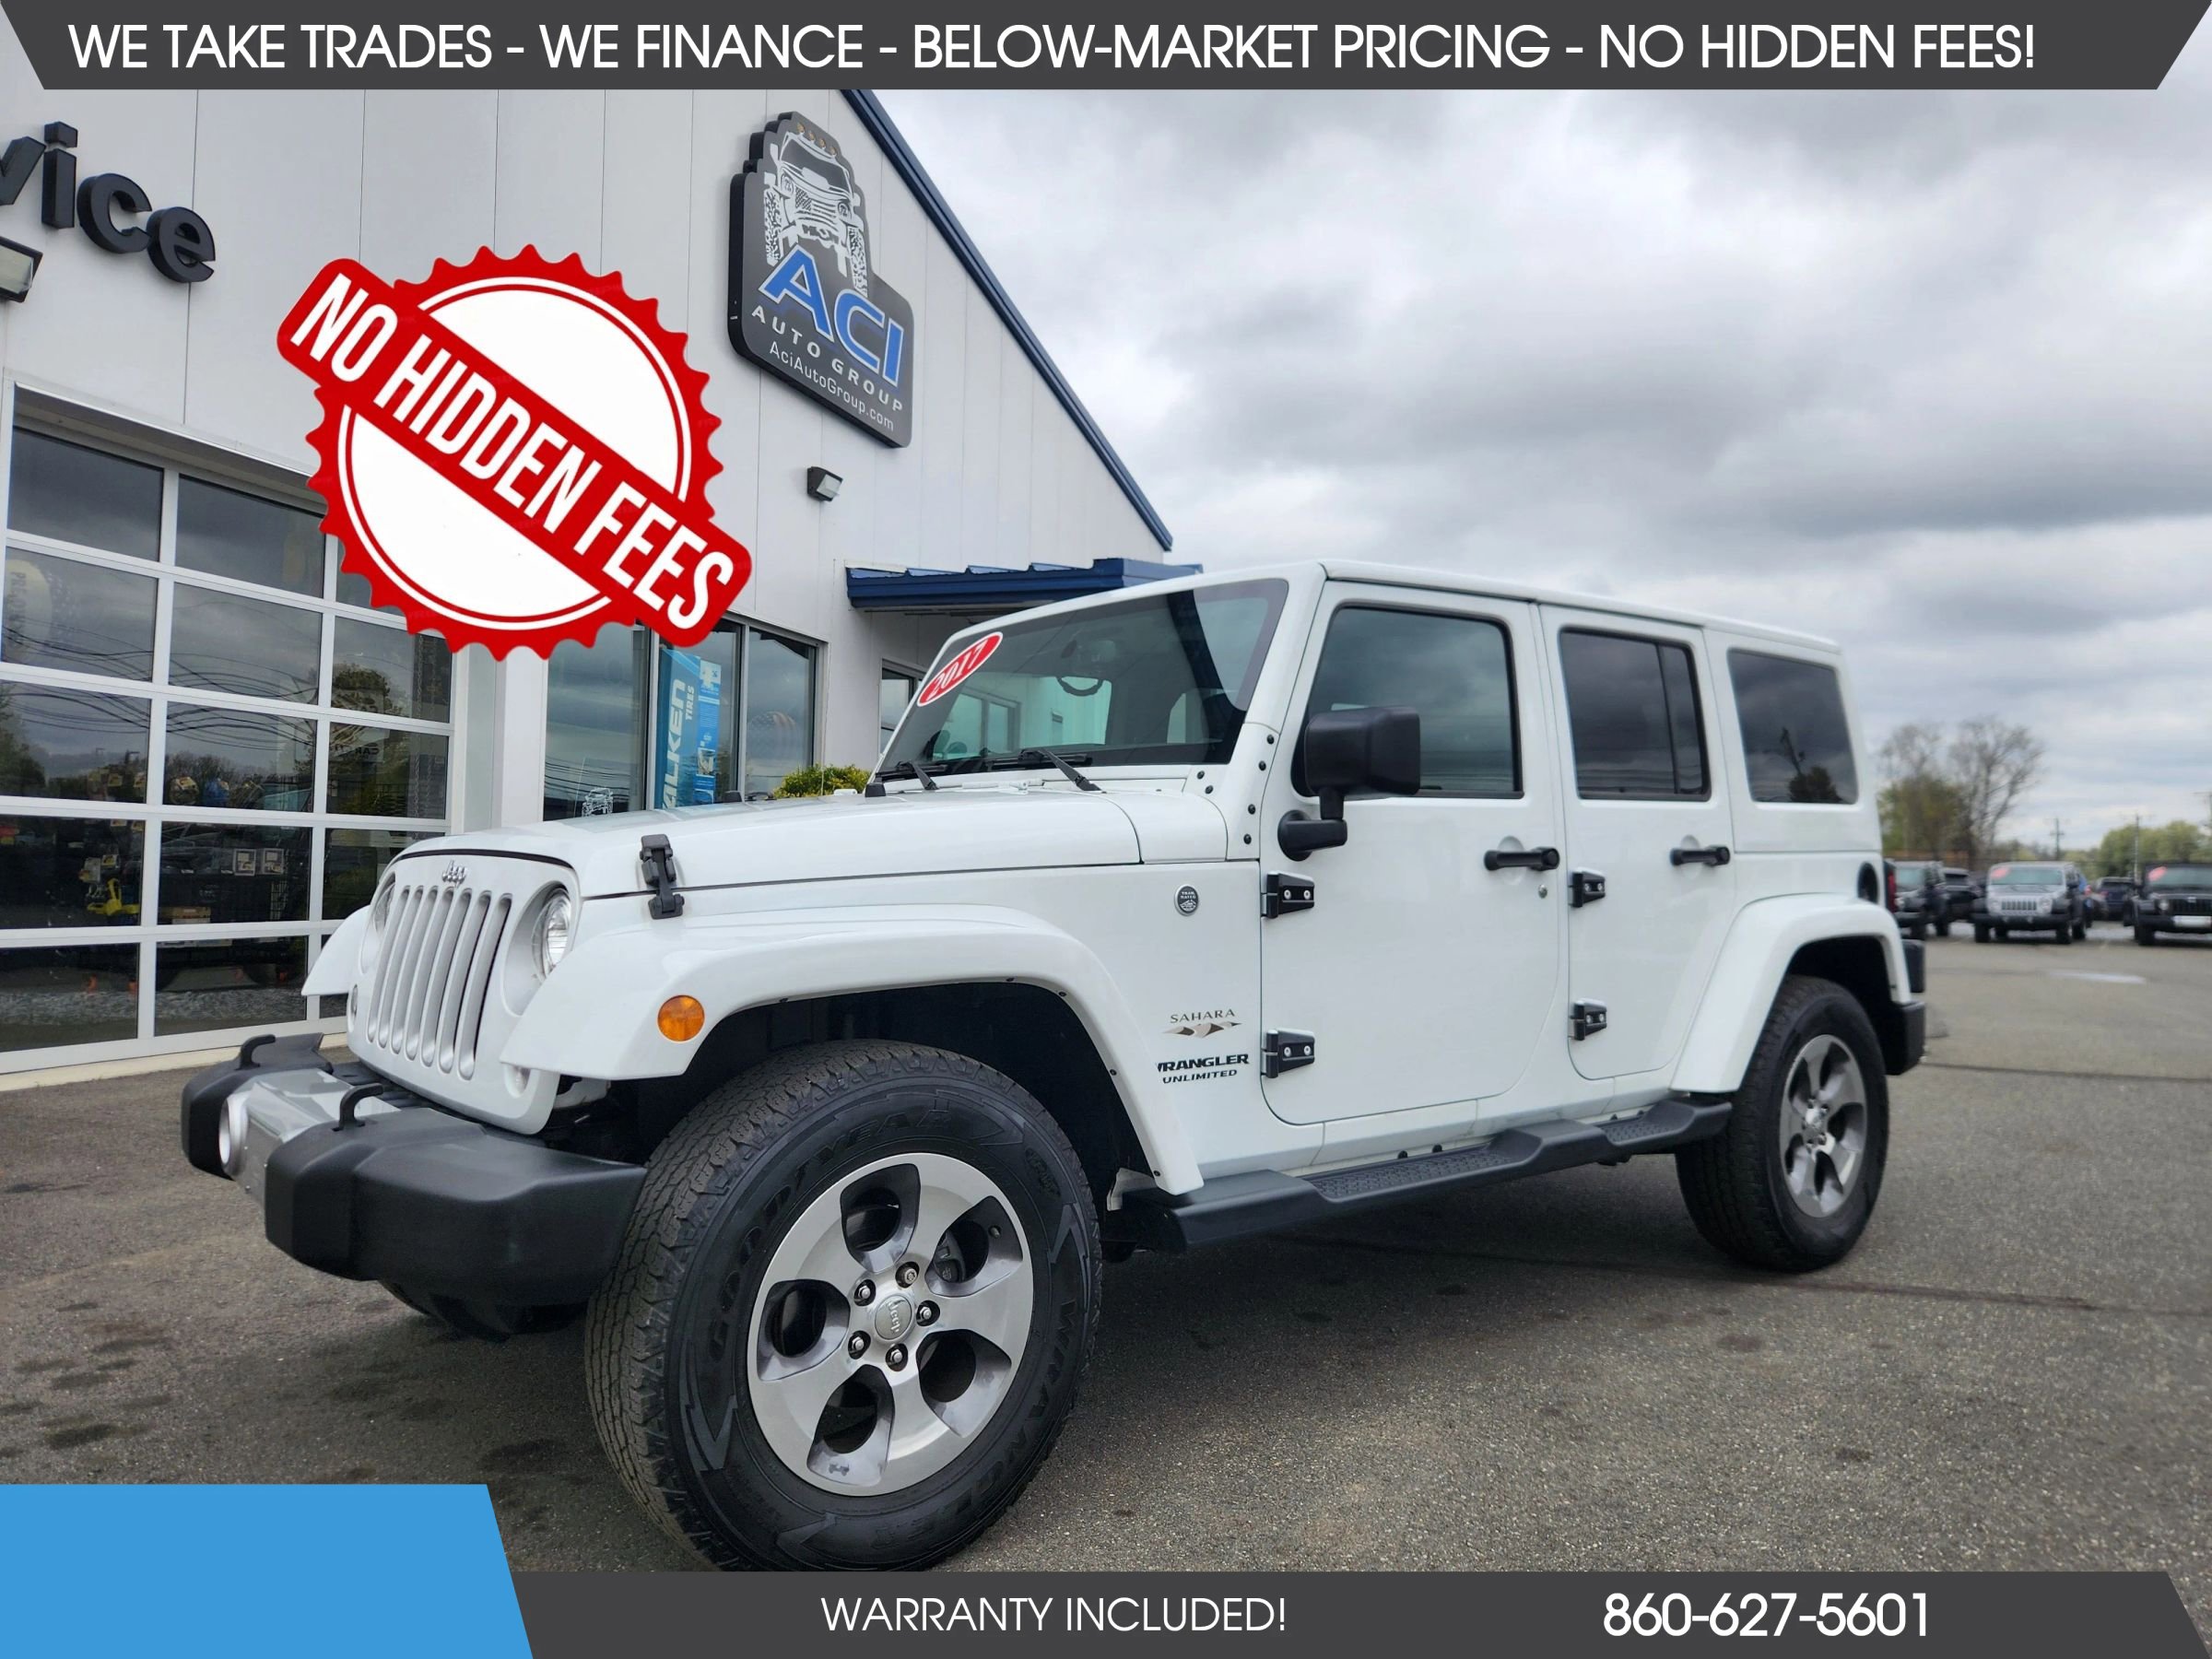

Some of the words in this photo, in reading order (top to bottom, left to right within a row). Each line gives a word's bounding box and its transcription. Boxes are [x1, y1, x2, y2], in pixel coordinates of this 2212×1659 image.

[758, 243, 905, 388] ACI
[751, 304, 821, 359] AUTO
[830, 358, 903, 411] GROUP
[769, 340, 895, 432] AciAutoGroup.com
[685, 685, 695, 721] TIRES
[925, 637, 989, 702] 2017
[662, 678, 687, 810] ALKEN
[1170, 1008, 1236, 1024] SAHARA
[1162, 1069, 1238, 1084] UNLIMITED
